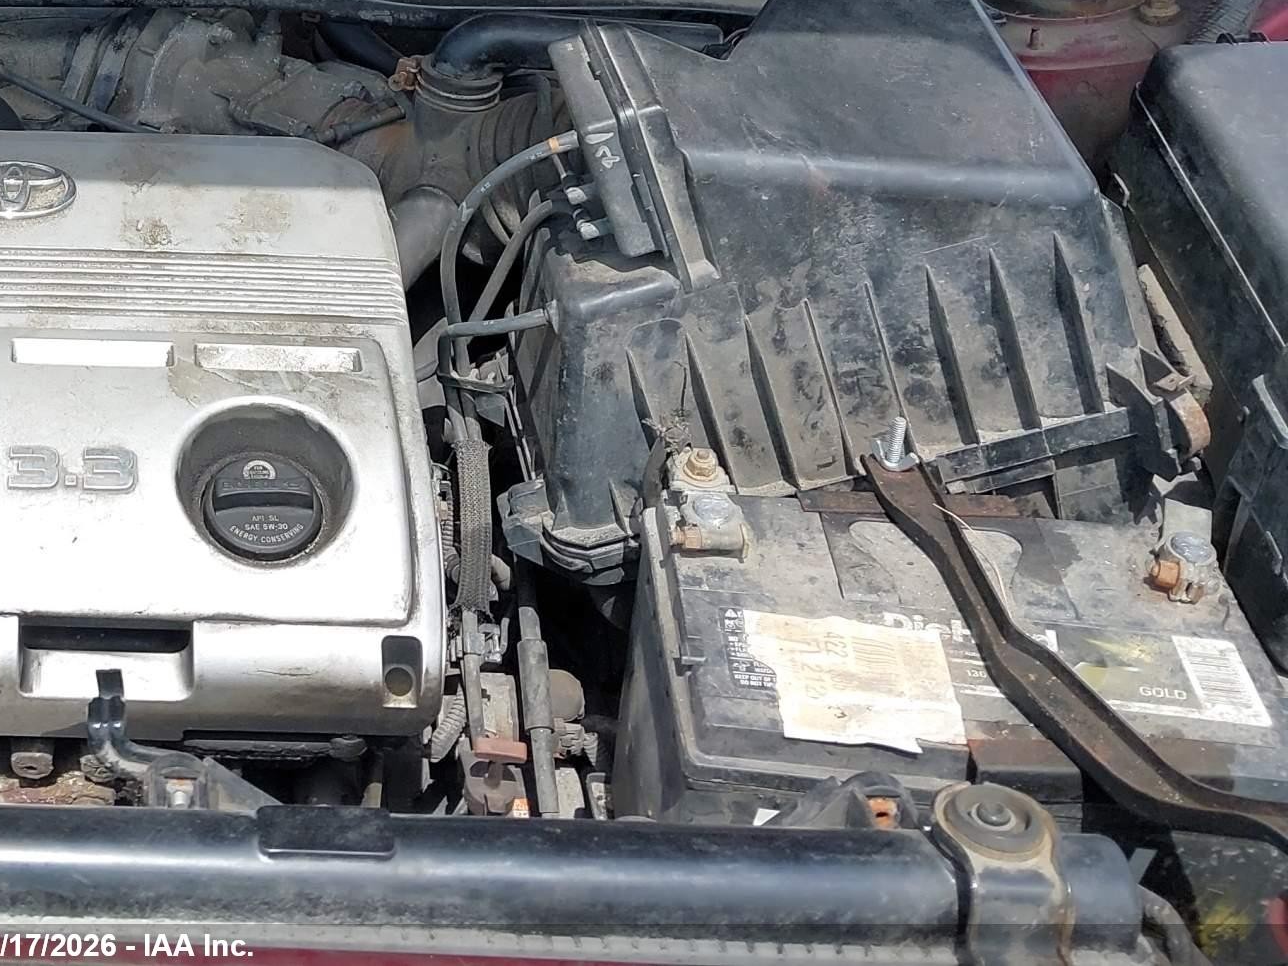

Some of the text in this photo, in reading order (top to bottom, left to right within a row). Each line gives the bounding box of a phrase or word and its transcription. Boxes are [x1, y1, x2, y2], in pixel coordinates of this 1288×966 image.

[7, 445, 137, 494] 3.3
[230, 523, 304, 543] ENERGY CONSERVING
[244, 523, 288, 531] SAE 5W-30
[1139, 686, 1188, 701] GOLD
